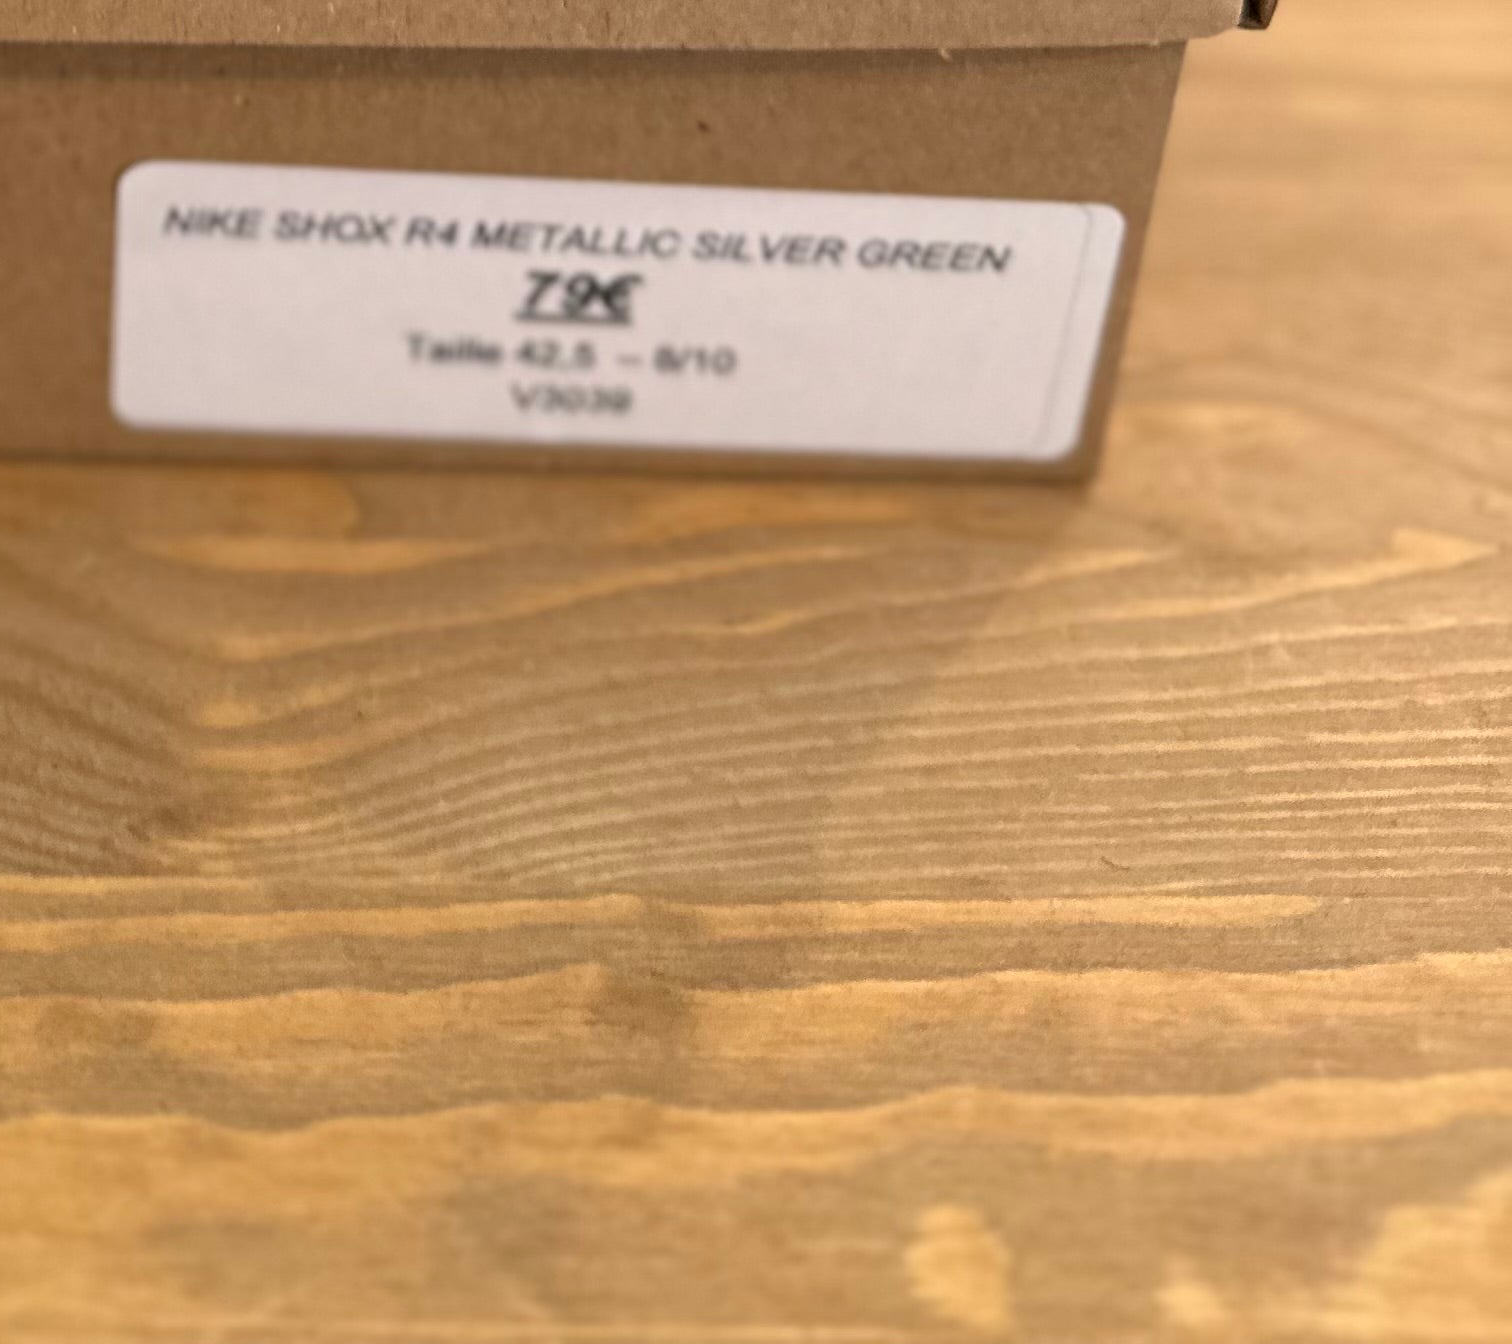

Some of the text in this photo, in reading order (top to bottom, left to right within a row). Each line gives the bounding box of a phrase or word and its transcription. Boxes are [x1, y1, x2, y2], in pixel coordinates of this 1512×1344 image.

[164, 206, 1012, 272] NIKE SHOX R4 METALLIC SILVER GREEN
[515, 269, 644, 324] 79€
[407, 332, 502, 363] Taille
[653, 346, 737, 375] 8/10
